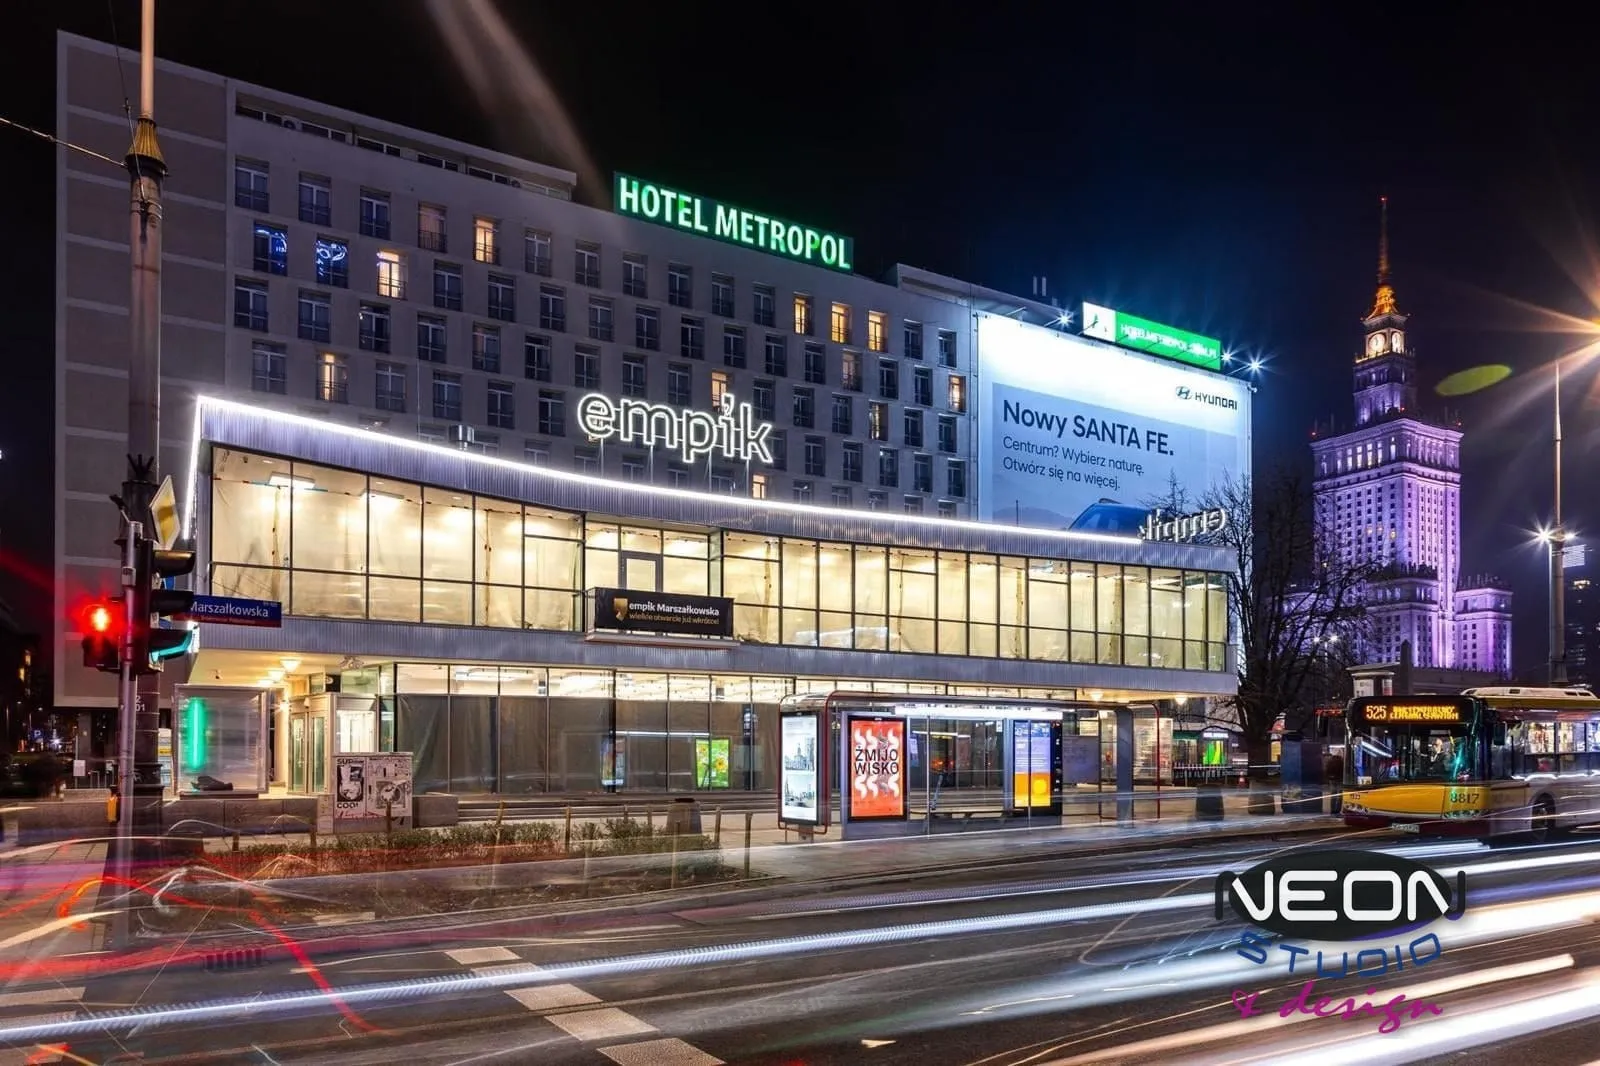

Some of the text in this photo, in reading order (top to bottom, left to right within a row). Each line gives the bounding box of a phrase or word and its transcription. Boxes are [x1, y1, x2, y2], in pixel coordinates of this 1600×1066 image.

[620, 177, 850, 269] HOTEL METROPOL
[1195, 392, 1237, 410] HYUNDAI
[577, 393, 773, 463] empik
[1003, 399, 1174, 456] Nowy SANTA FE.
[1003, 436, 1145, 477] Centrum? Wybierz naturę.
[1003, 456, 1121, 490] Otwórz się na więcej.
[629, 601, 719, 616] empik Marszałkowska
[629, 612, 653, 620] wielkie
[654, 614, 681, 622] otwarcie
[682, 615, 691, 624] już
[1366, 705, 1387, 719] 525
[855, 745, 898, 761] ŻMIJO
[854, 762, 899, 775] WISKO
[1450, 792, 1479, 804] 8817
